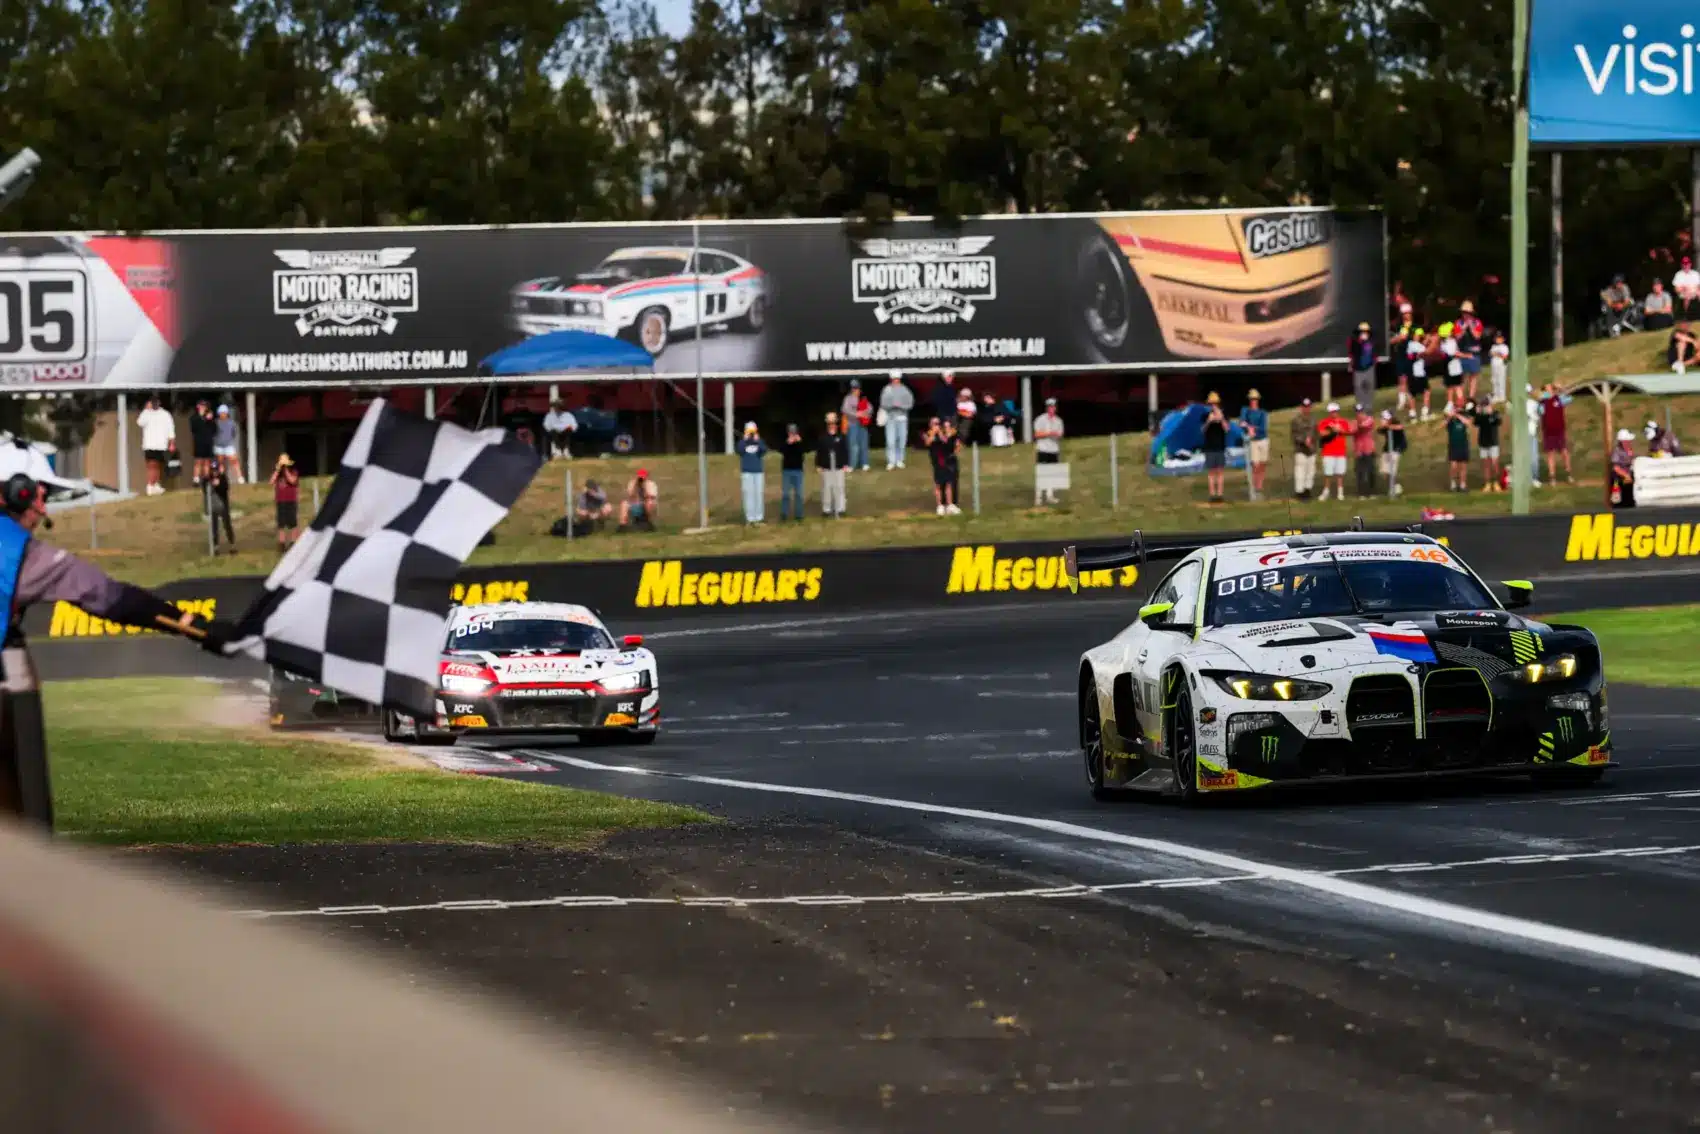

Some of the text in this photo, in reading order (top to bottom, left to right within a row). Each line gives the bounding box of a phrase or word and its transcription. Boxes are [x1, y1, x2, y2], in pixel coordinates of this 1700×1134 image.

[1574, 24, 1700, 95] visi
[891, 240, 957, 255] NATIONAL
[312, 253, 379, 267] NATIONAL
[860, 261, 990, 291] MOTOR RACING
[281, 273, 412, 302] MOTOR RACING
[895, 289, 954, 304] MUSEUM
[317, 301, 375, 317] MUSEUM
[892, 312, 958, 325] BATHURST
[313, 324, 380, 338] BATHURST
[805, 338, 1046, 362] WWW.MUSEUMSBATHURST.COM.AU
[226, 350, 467, 373] WWW.MUSEUMSBATHURST.COM.AU
[1409, 548, 1449, 564] 46
[1217, 570, 1279, 597] 003
[1445, 618, 1499, 627] Motorsport
[453, 703, 475, 714] KFC
